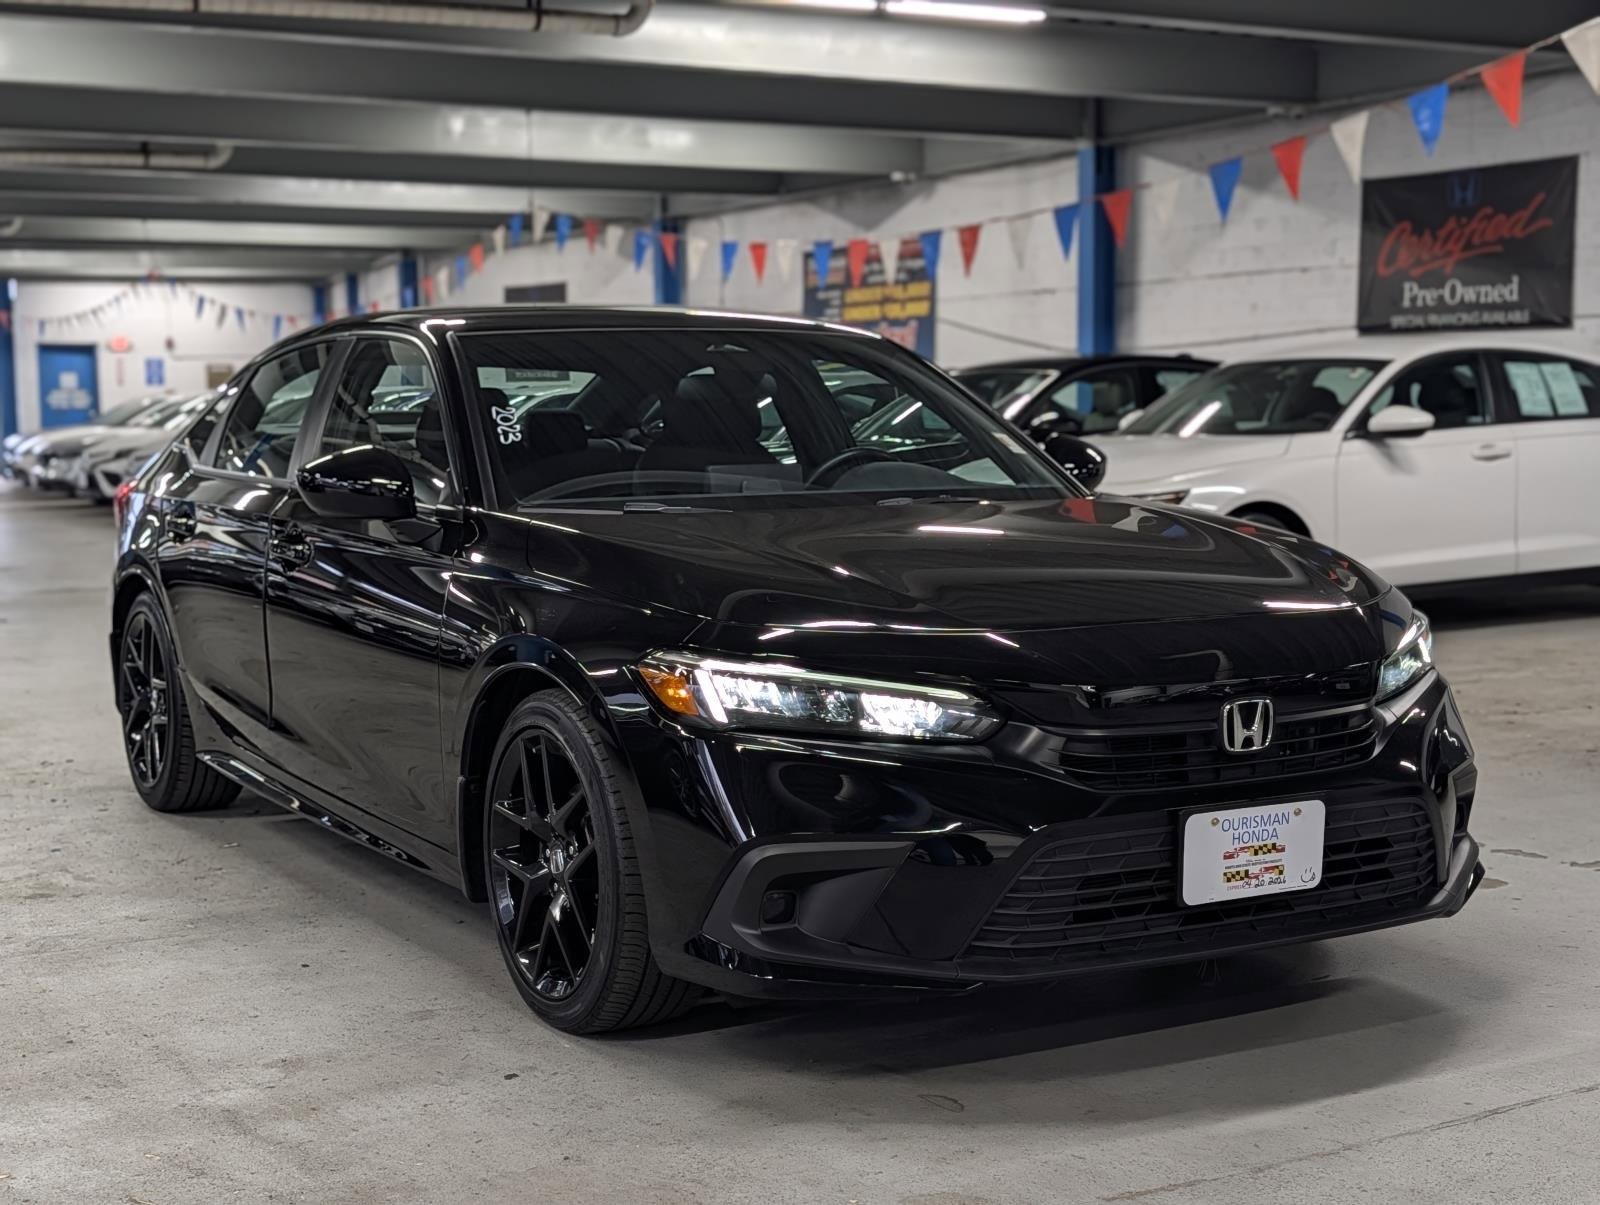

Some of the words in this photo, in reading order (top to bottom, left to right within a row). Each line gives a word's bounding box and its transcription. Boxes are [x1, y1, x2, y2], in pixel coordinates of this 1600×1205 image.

[1376, 192, 1553, 278] Certified
[1402, 274, 1520, 308] Pre-Owned
[491, 405, 522, 445] 2023
[1221, 811, 1291, 833] OURISMAN
[1231, 827, 1279, 846] HONDA
